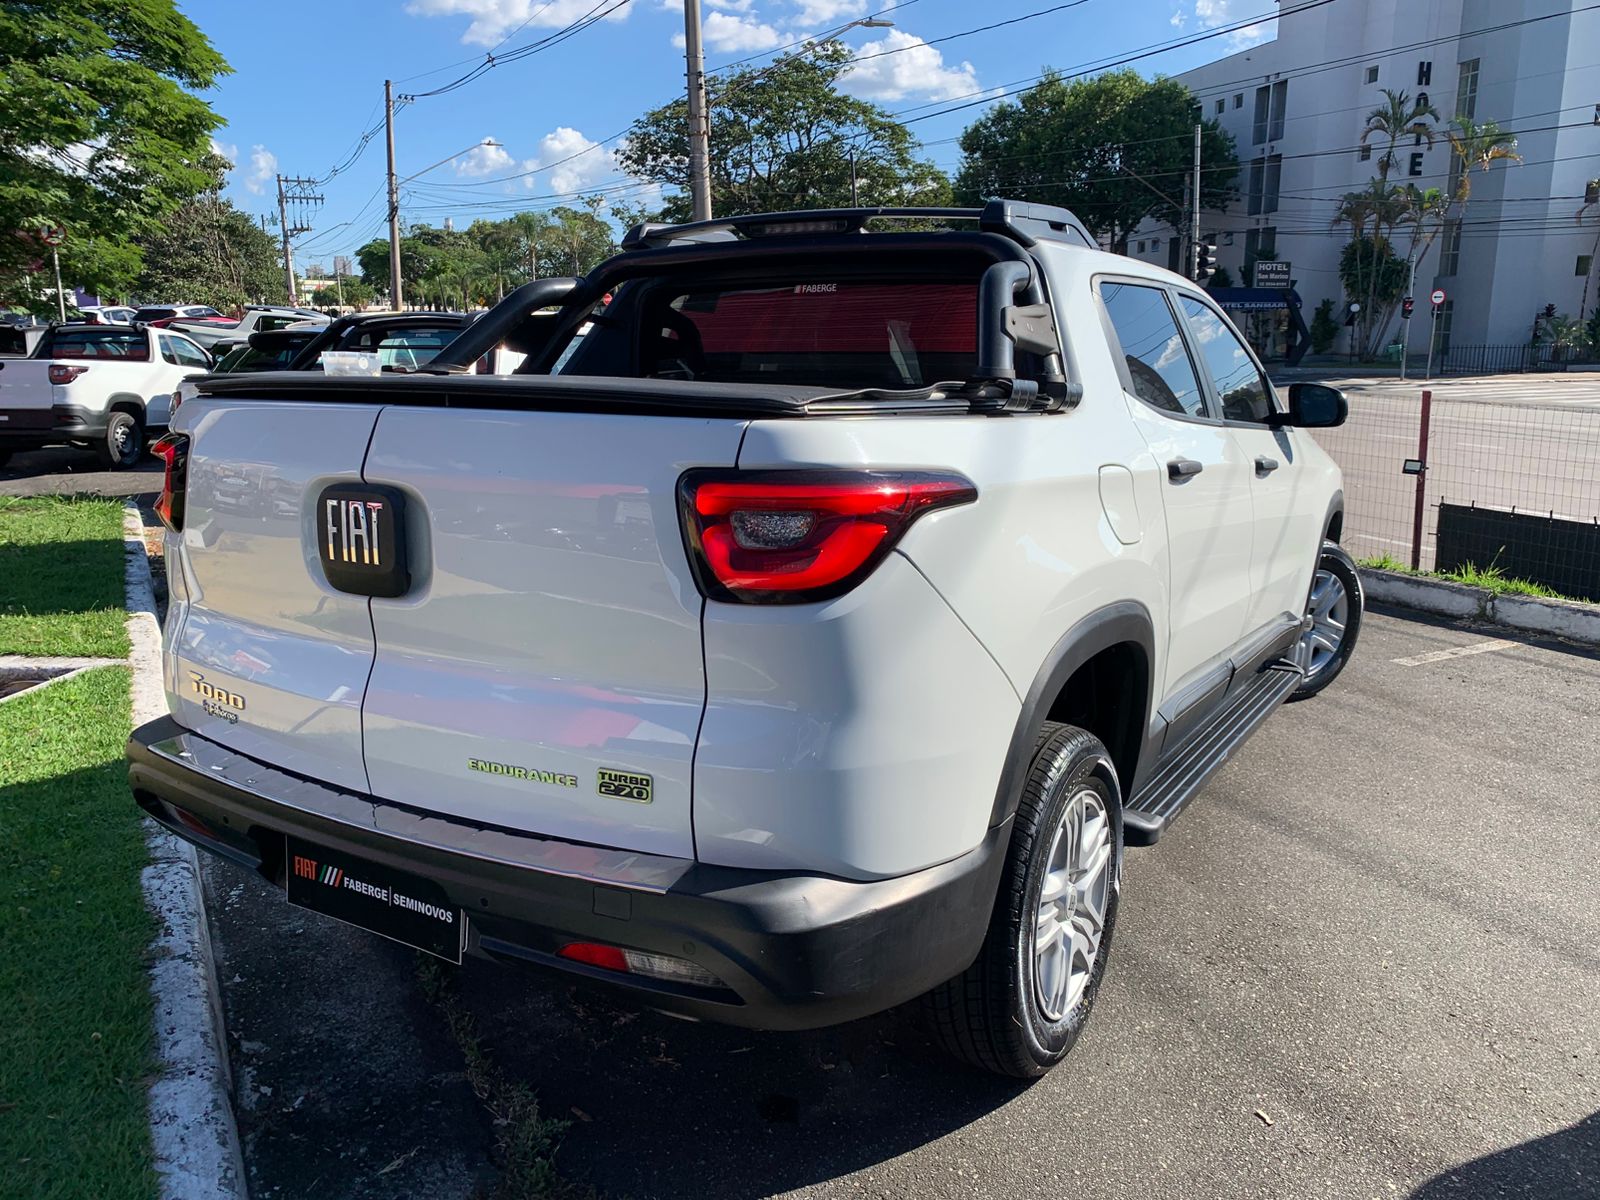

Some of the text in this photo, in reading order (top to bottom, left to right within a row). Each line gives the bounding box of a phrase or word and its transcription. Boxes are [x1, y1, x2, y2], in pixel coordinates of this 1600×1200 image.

[1408, 61, 1432, 190] HOTE
[1258, 263, 1289, 271] HOTEL
[802, 283, 838, 294] FABERGE
[326, 499, 384, 566] FIAT
[187, 670, 246, 710] TORO
[467, 758, 578, 788] ENDURANCE
[599, 771, 651, 787] TURBO
[599, 781, 650, 801] 270
[294, 855, 453, 924] FIAT FABERGE SEMINOVOS
